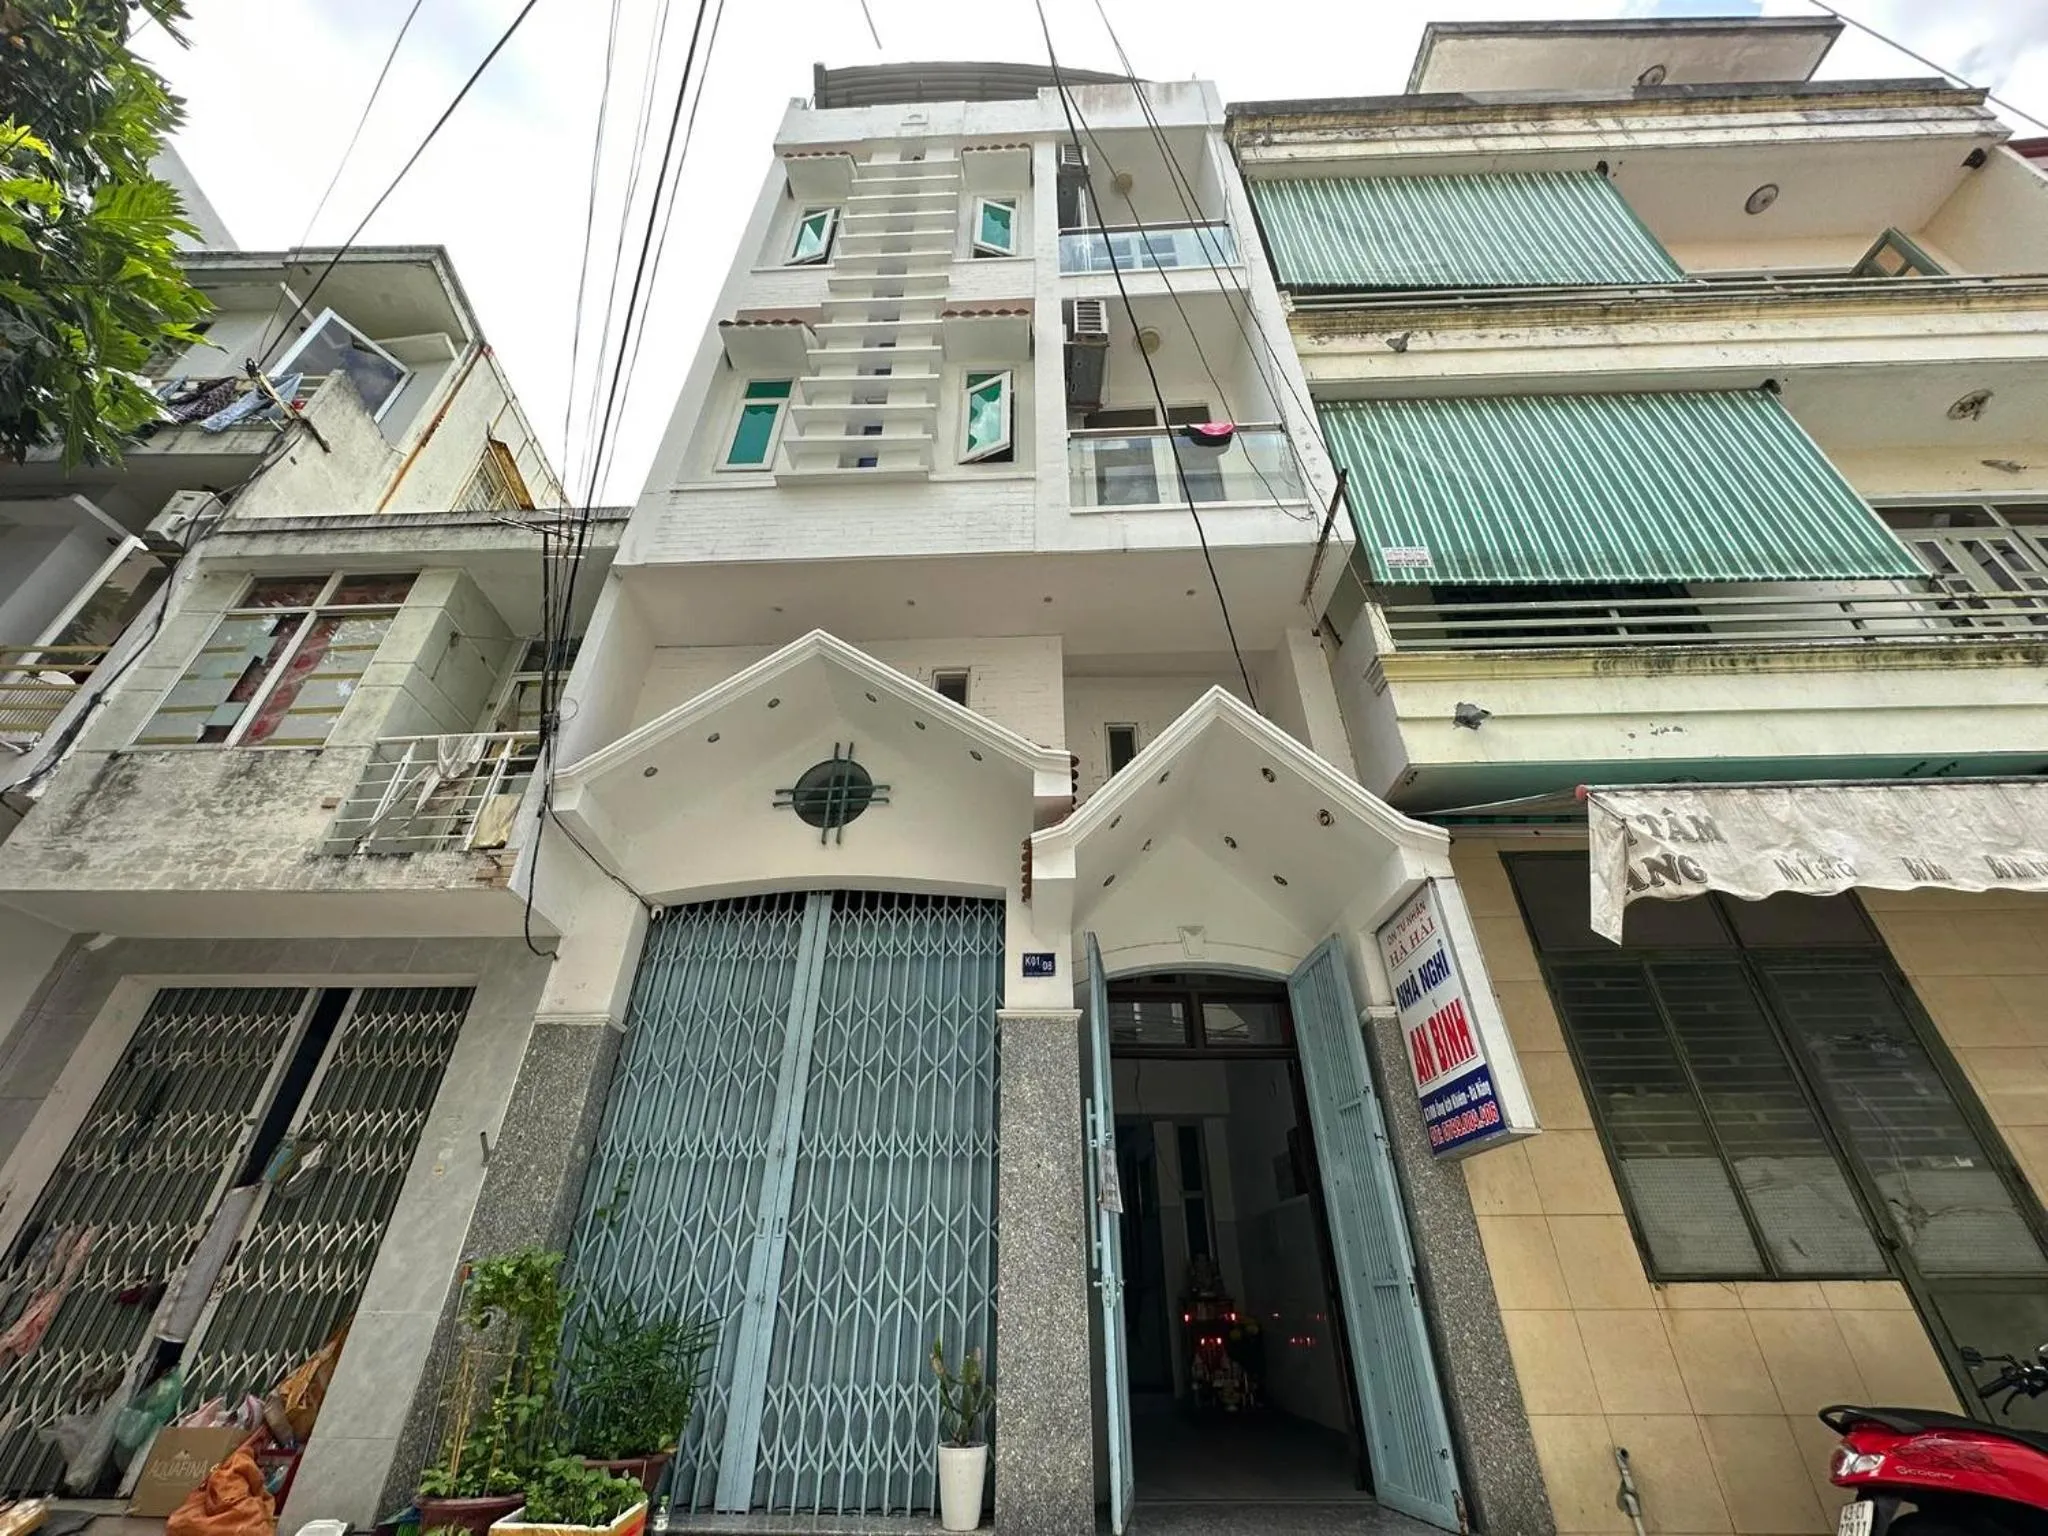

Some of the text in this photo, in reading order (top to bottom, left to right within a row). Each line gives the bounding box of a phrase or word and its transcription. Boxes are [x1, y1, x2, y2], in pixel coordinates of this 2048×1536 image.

[1396, 938, 1451, 1012] NHÀ NGHỈ
[1409, 1023, 1437, 1086] AN
